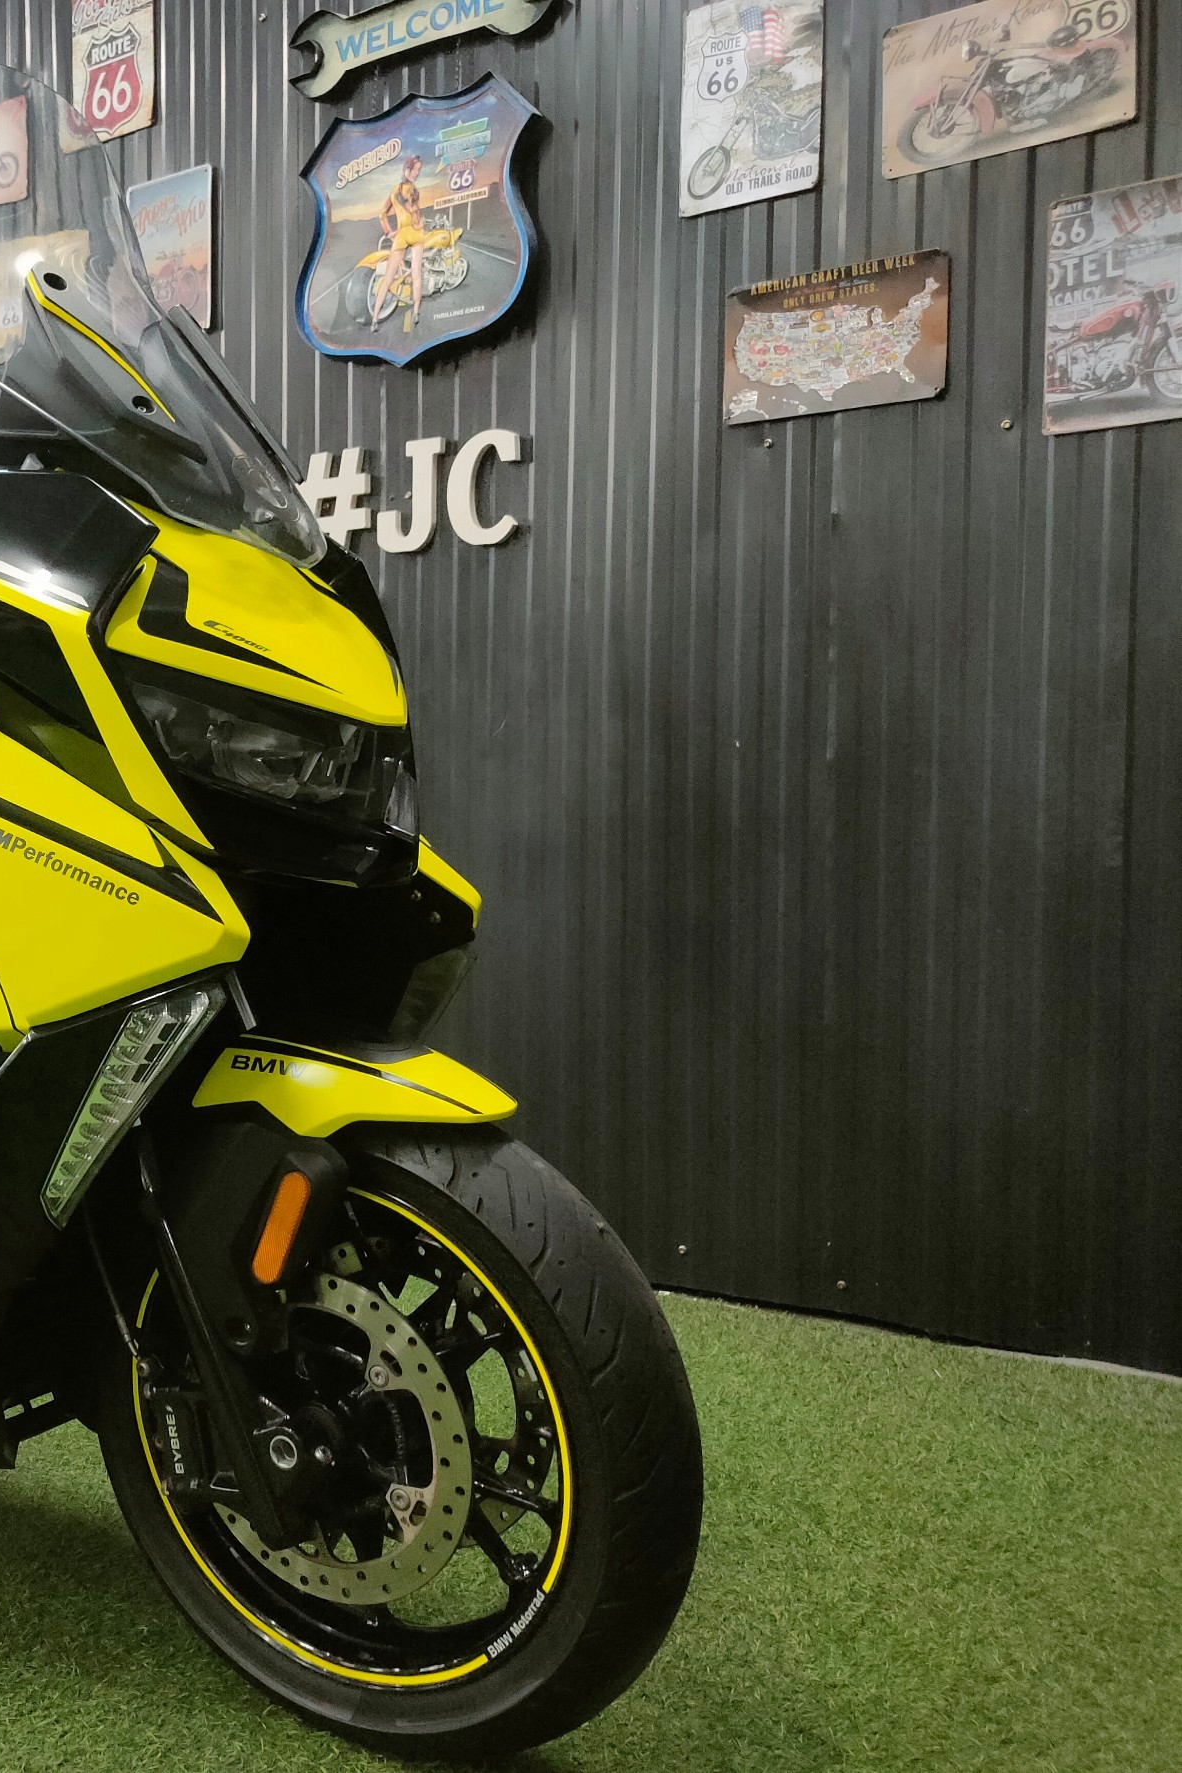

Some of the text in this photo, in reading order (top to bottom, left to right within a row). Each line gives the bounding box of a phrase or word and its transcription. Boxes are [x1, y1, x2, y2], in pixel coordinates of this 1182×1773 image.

[336, 0, 505, 63] WELCOME
[710, 35, 742, 54] ROUTE
[91, 34, 135, 64] ROUTE
[92, 64, 132, 120] 66
[706, 67, 739, 96] 66
[335, 138, 402, 190] SPEED
[450, 169, 473, 190] 66
[724, 152, 798, 184] National
[725, 165, 813, 196] OLD TRAILS ROAD
[1051, 218, 1086, 247] 66
[751, 275, 807, 296] AMERICAN
[811, 266, 845, 284] CRAFT
[851, 260, 879, 277] BEER
[884, 254, 916, 270] WEEK
[296, 429, 521, 553] #JC
[230, 1054, 308, 1079] BMW
[486, 1588, 546, 1659] BMW Motorrad
